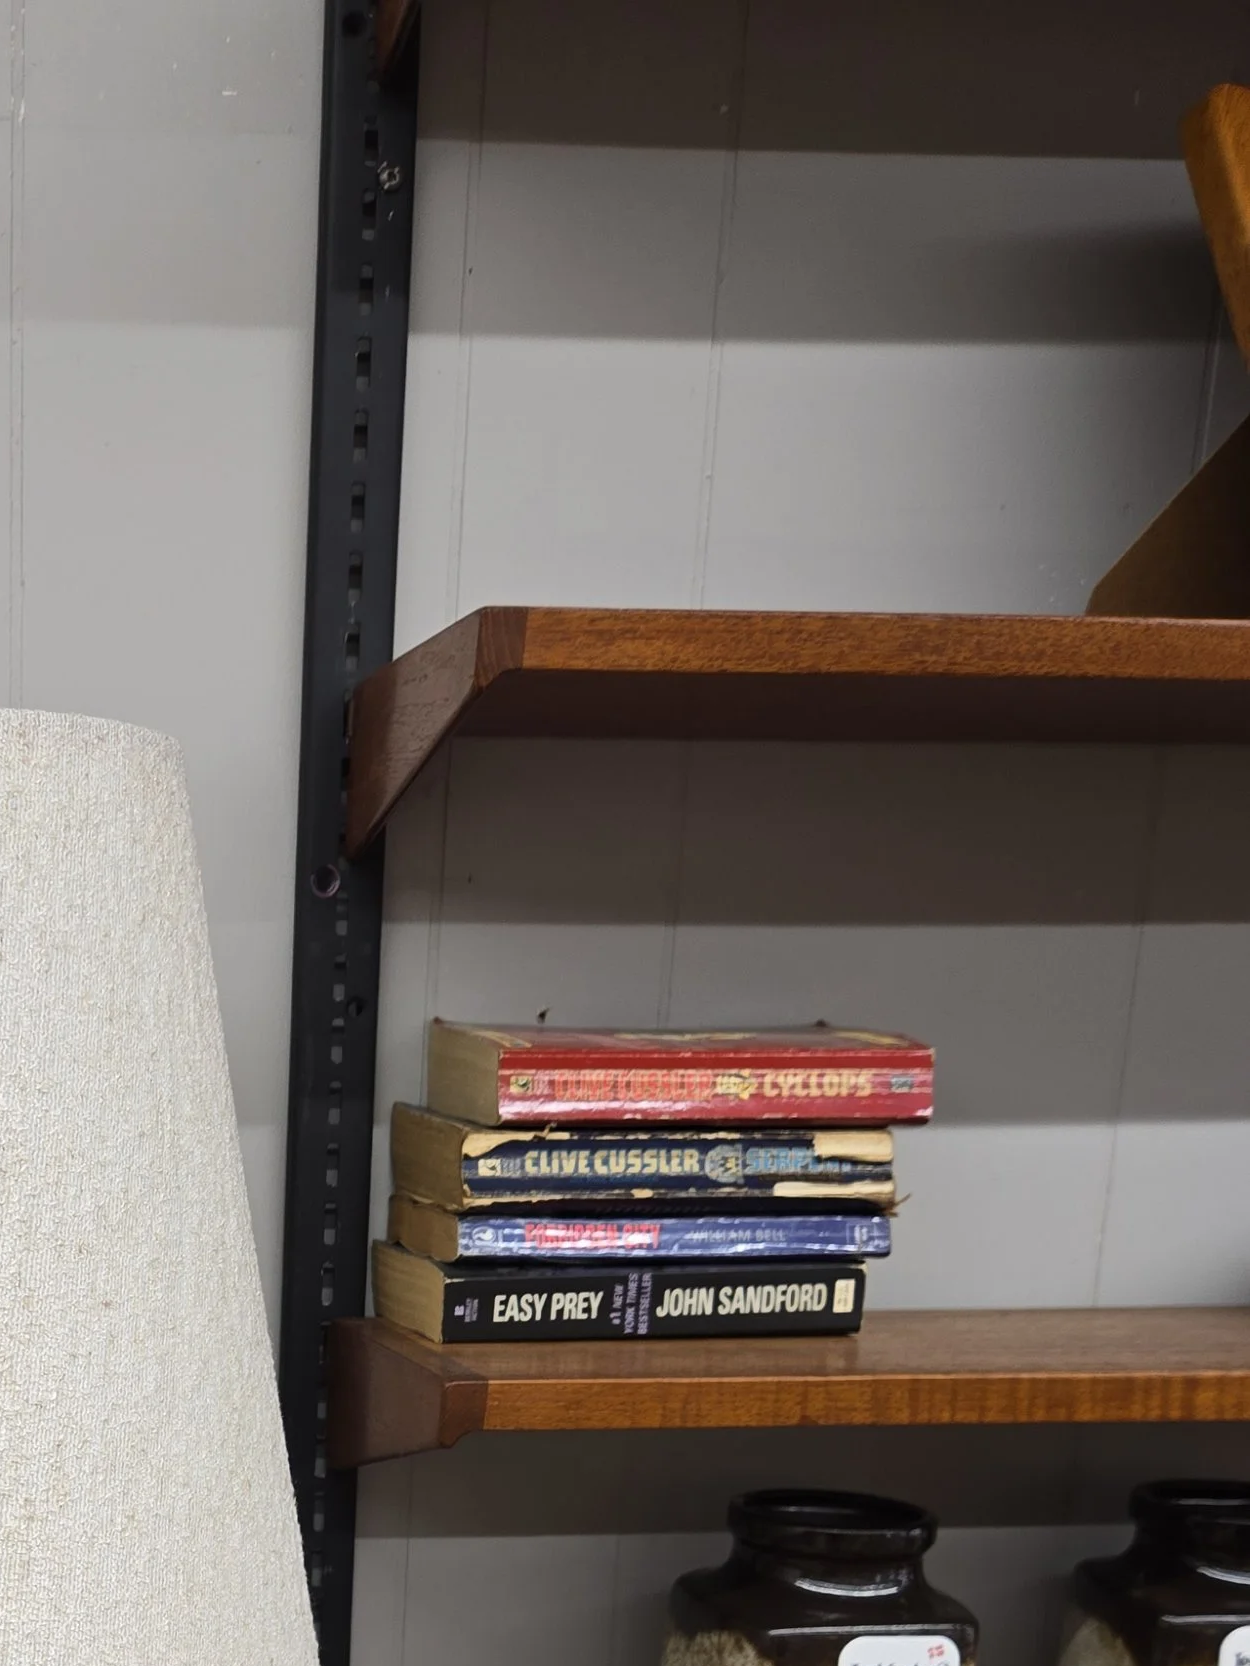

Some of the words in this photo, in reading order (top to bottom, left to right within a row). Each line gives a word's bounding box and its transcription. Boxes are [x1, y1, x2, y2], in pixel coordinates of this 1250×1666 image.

[763, 1070, 874, 1097] CYCLOPS
[525, 1149, 591, 1174] CLIVE
[594, 1149, 700, 1174] CUSSLER
[622, 1223, 660, 1249] CITY
[755, 1228, 787, 1242] BELL
[612, 1285, 623, 1308] NEW
[626, 1273, 638, 1303] TIMES
[656, 1287, 714, 1318] JOHN
[717, 1283, 828, 1315] SANDFORD
[493, 1293, 548, 1323] EASY
[550, 1291, 604, 1321] PREY
[637, 1272, 651, 1335] BESTSELLER
[624, 1306, 635, 1334] YORK
